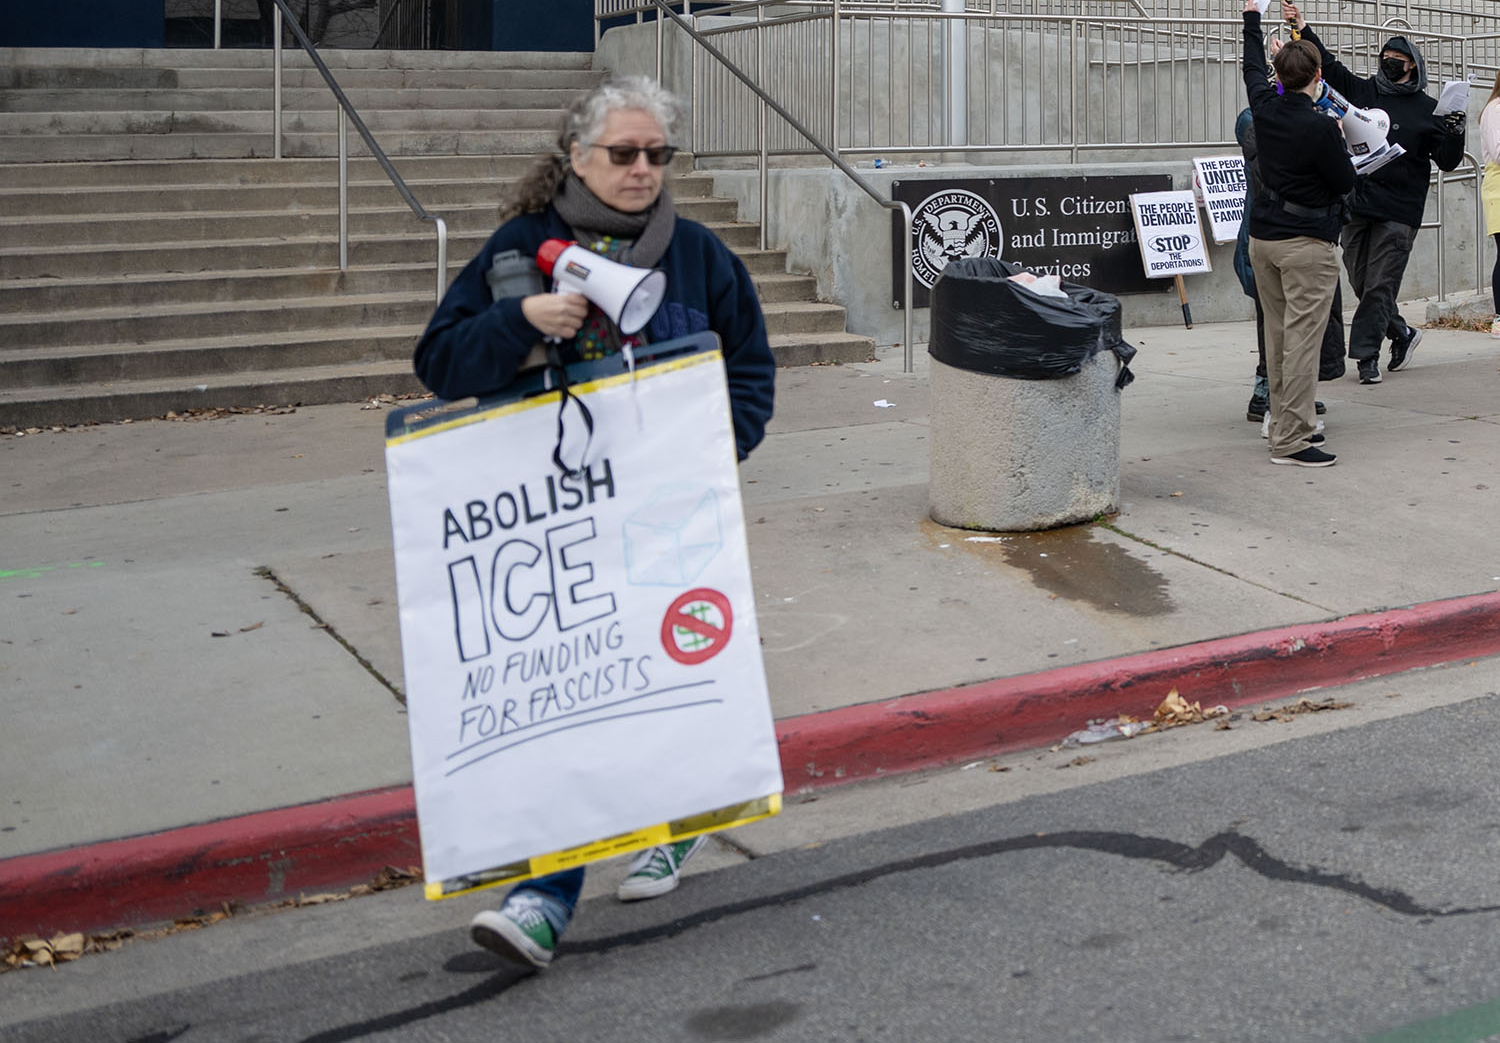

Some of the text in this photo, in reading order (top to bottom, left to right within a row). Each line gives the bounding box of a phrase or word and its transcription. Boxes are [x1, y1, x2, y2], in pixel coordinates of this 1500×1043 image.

[1200, 159, 1245, 171] THE PEOPL
[1203, 168, 1246, 185] UNITE
[1207, 182, 1248, 194] WILL DEFE
[1060, 196, 1131, 216] Citizen
[1138, 202, 1195, 215] THE PEOPLE
[1208, 197, 1246, 211] IMMIGR
[925, 194, 991, 219] DEPARTMENT
[986, 219, 998, 234] OF
[1140, 212, 1197, 227] DEMAND:
[1212, 209, 1245, 223] FAMI
[1011, 226, 1138, 249] and Immigrat
[1155, 234, 1191, 253] STOP
[912, 248, 937, 284] HOMEL
[1151, 258, 1204, 271] DEPORTATIONS!
[442, 458, 617, 549] ABOLISH
[448, 516, 617, 663] ICE
[461, 621, 625, 702] NO FUNDING
[459, 655, 653, 744] FOR FASCISTS
